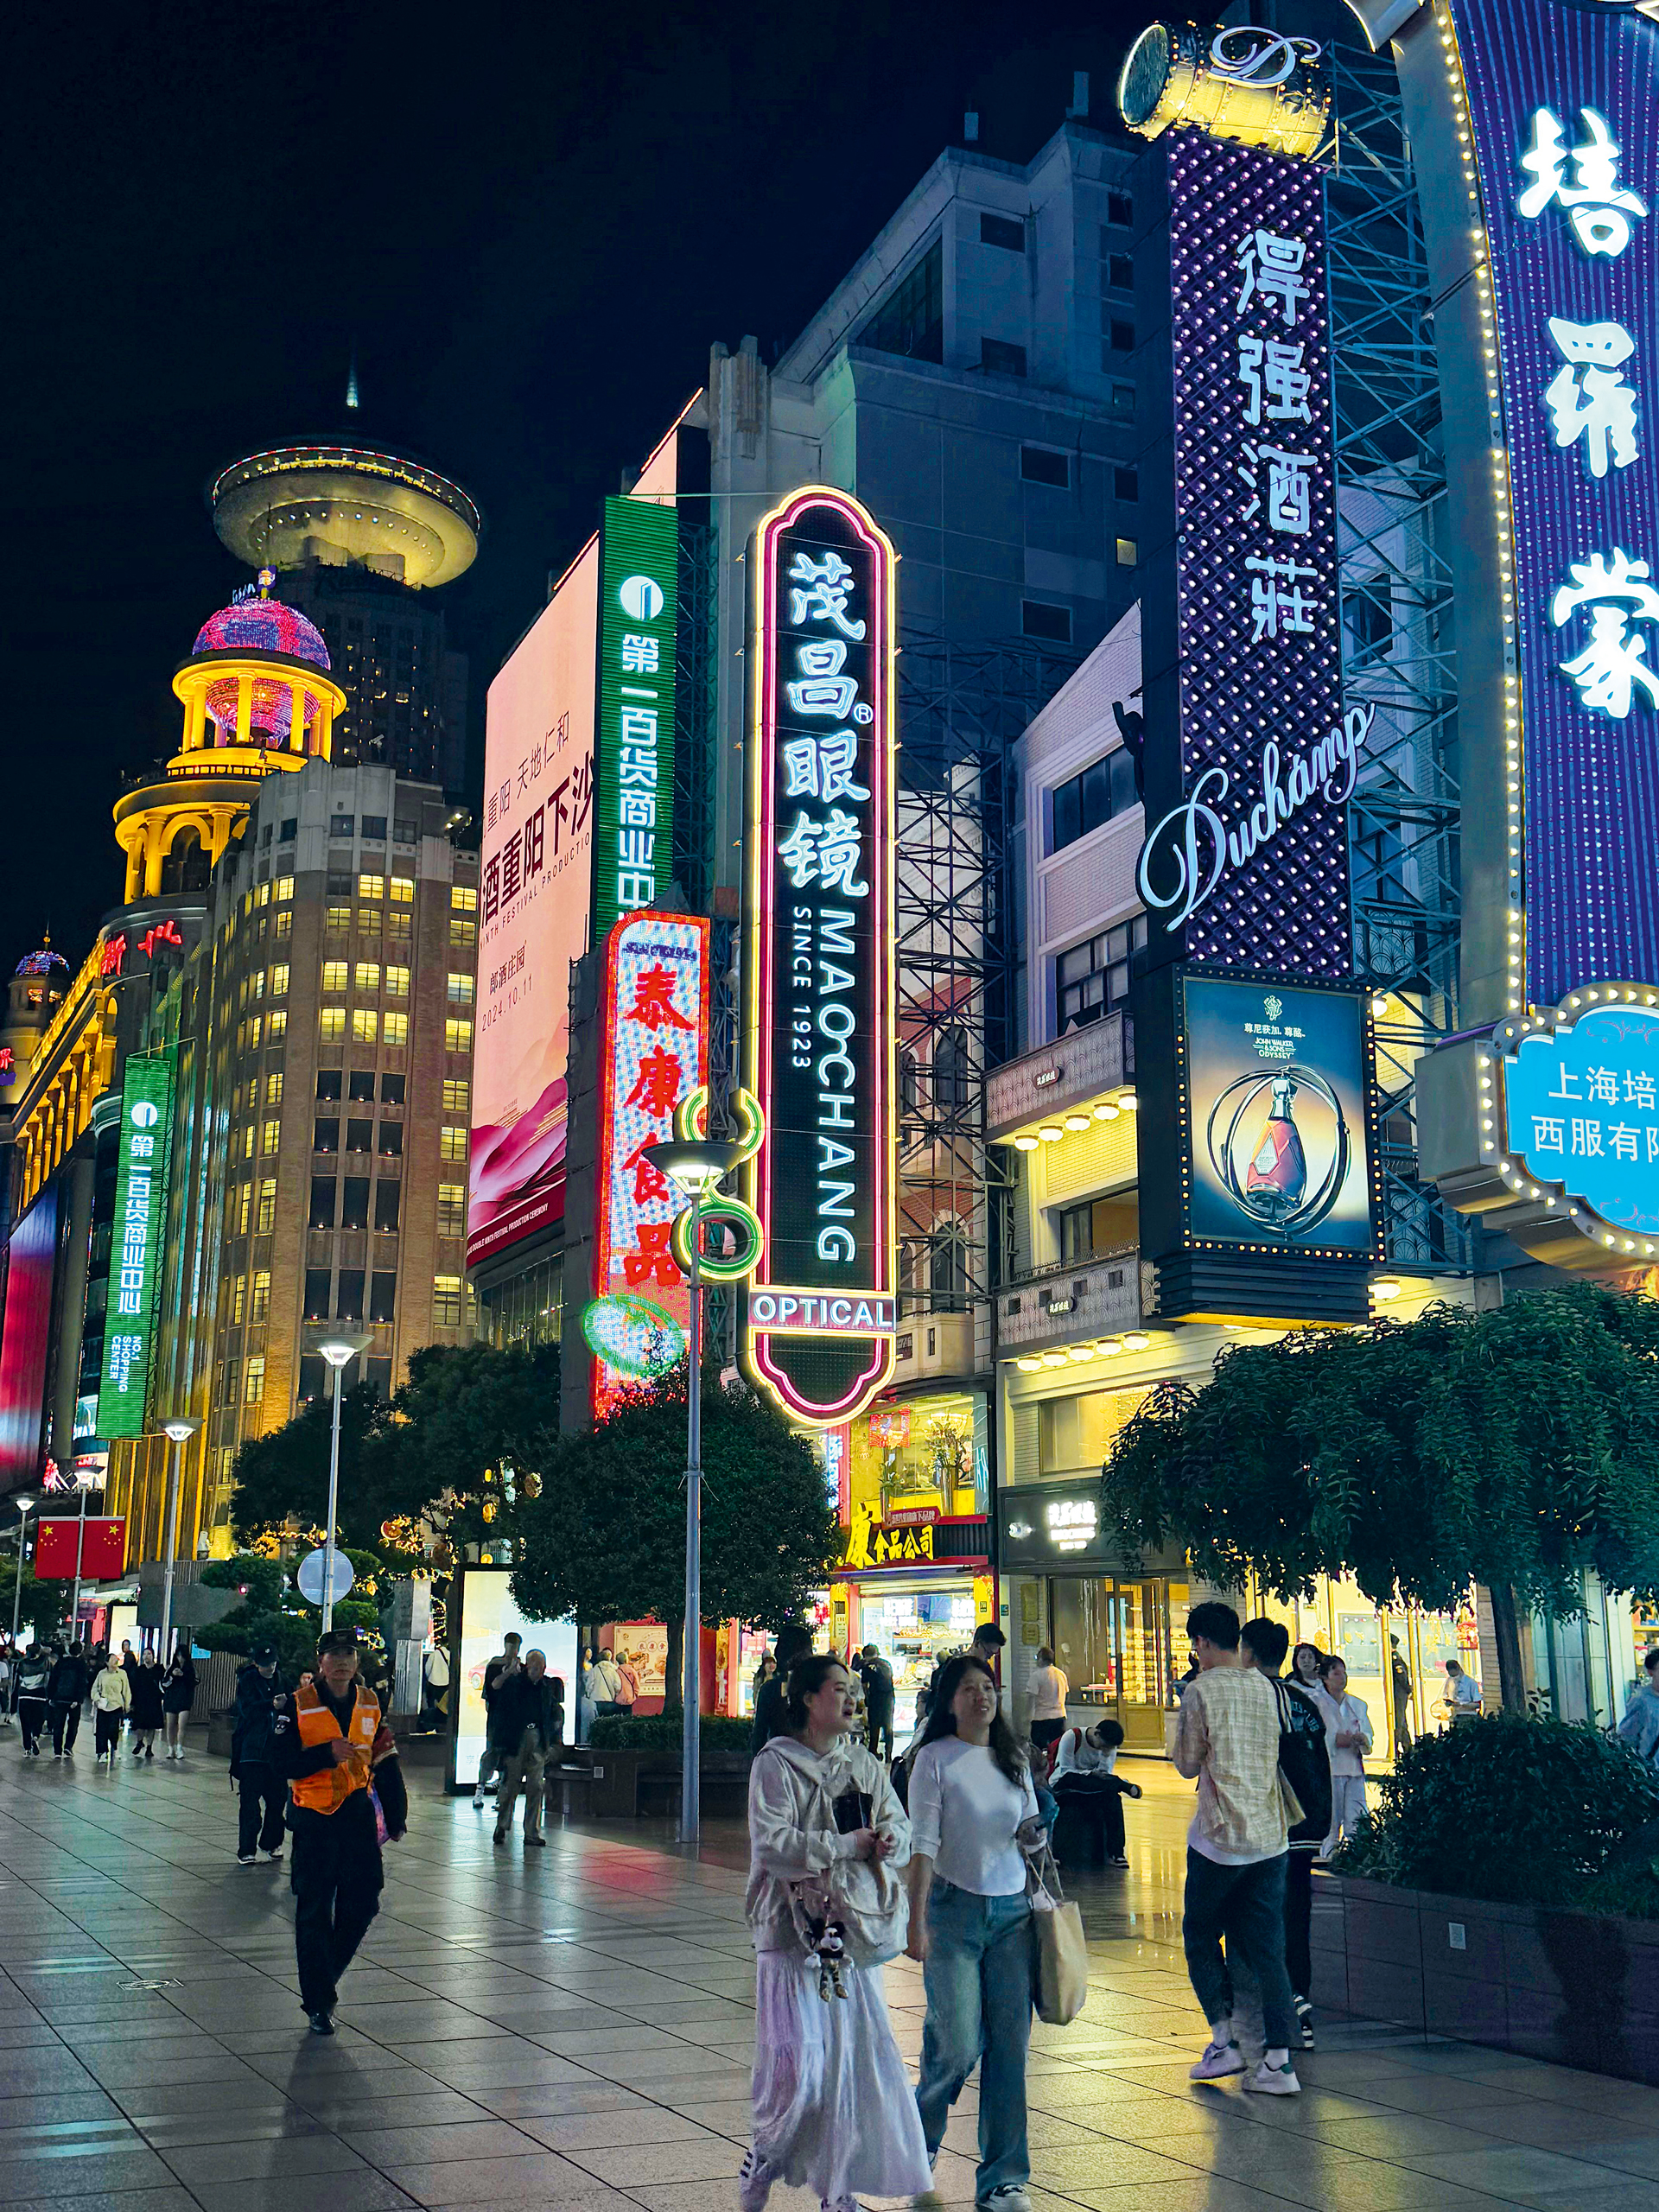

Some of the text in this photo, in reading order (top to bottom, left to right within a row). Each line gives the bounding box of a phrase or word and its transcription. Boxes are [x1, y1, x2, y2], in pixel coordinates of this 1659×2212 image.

[777, 550, 872, 899] 茂昌眼镜
[483, 710, 569, 839] 重阳 天地仁和
[617, 632, 661, 919] 第一百货商业中
[502, 884, 538, 929] FESTIVAL
[481, 972, 532, 1032] 2024.10.11
[792, 906, 813, 1070] SINCE 1923
[1258, 1049, 1292, 1060] ODYSSEY
[1271, 1039, 1294, 1048] WALKER
[817, 908, 857, 1263] MAOCHANG
[1548, 1061, 1657, 1110] 上海培
[620, 962, 696, 1287] 泰康食品
[118, 1134, 156, 1315] 第一百货商业中心
[752, 1294, 893, 1329] OPTICAL
[109, 1335, 122, 1380] CENTER
[118, 1336, 132, 1393] SHOPPING
[130, 1335, 143, 1361] NO.1
[836, 1502, 934, 1570] 康食品公司
